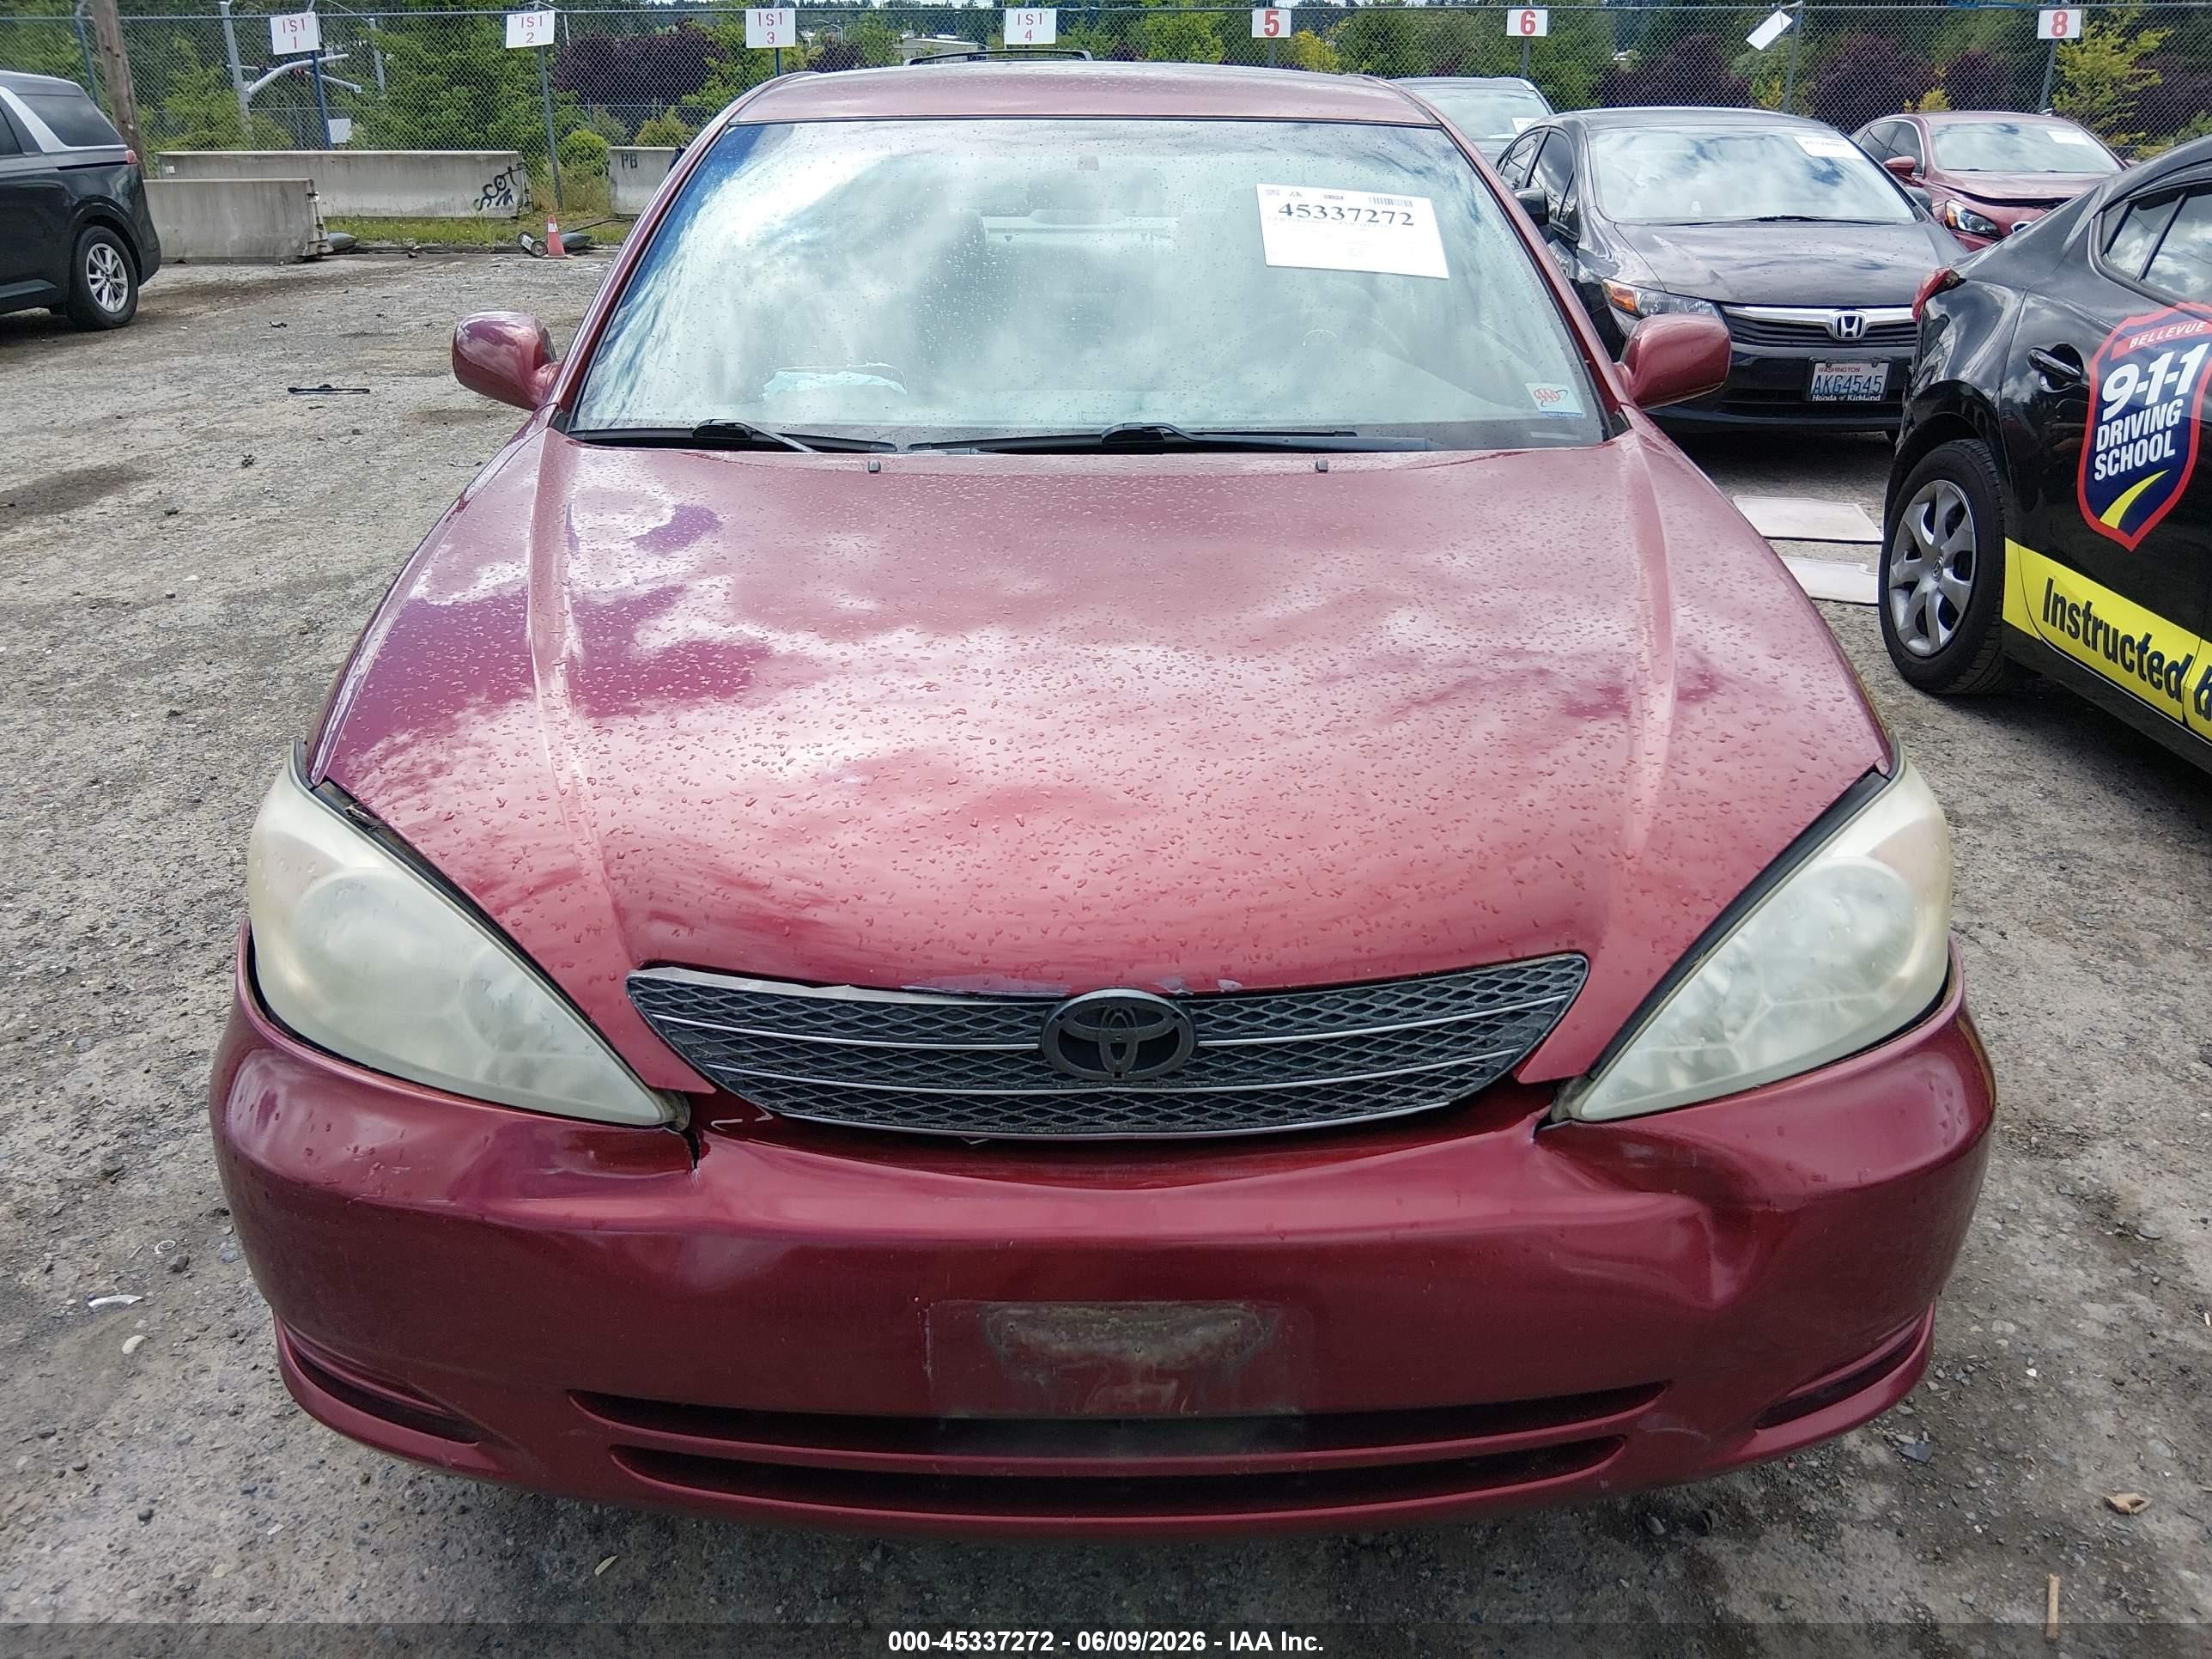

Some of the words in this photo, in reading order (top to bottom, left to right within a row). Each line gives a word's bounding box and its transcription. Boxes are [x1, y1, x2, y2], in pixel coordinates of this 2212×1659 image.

[1024, 28, 1032, 42] 4
[1263, 9, 1279, 37] 5
[1520, 10, 1536, 35] 6
[2051, 10, 2069, 37] 8
[526, 32, 535, 44] 2
[766, 31, 775, 45] 3
[1278, 203, 1414, 226] 45337272
[2129, 321, 2207, 349] BELLEVUE
[1813, 375, 1883, 394] AKG4545
[2102, 343, 2210, 422] 9-1-1
[2096, 398, 2184, 453] DRIVING
[2094, 430, 2176, 481] SCHOOL
[2042, 576, 2194, 704] Instructed
